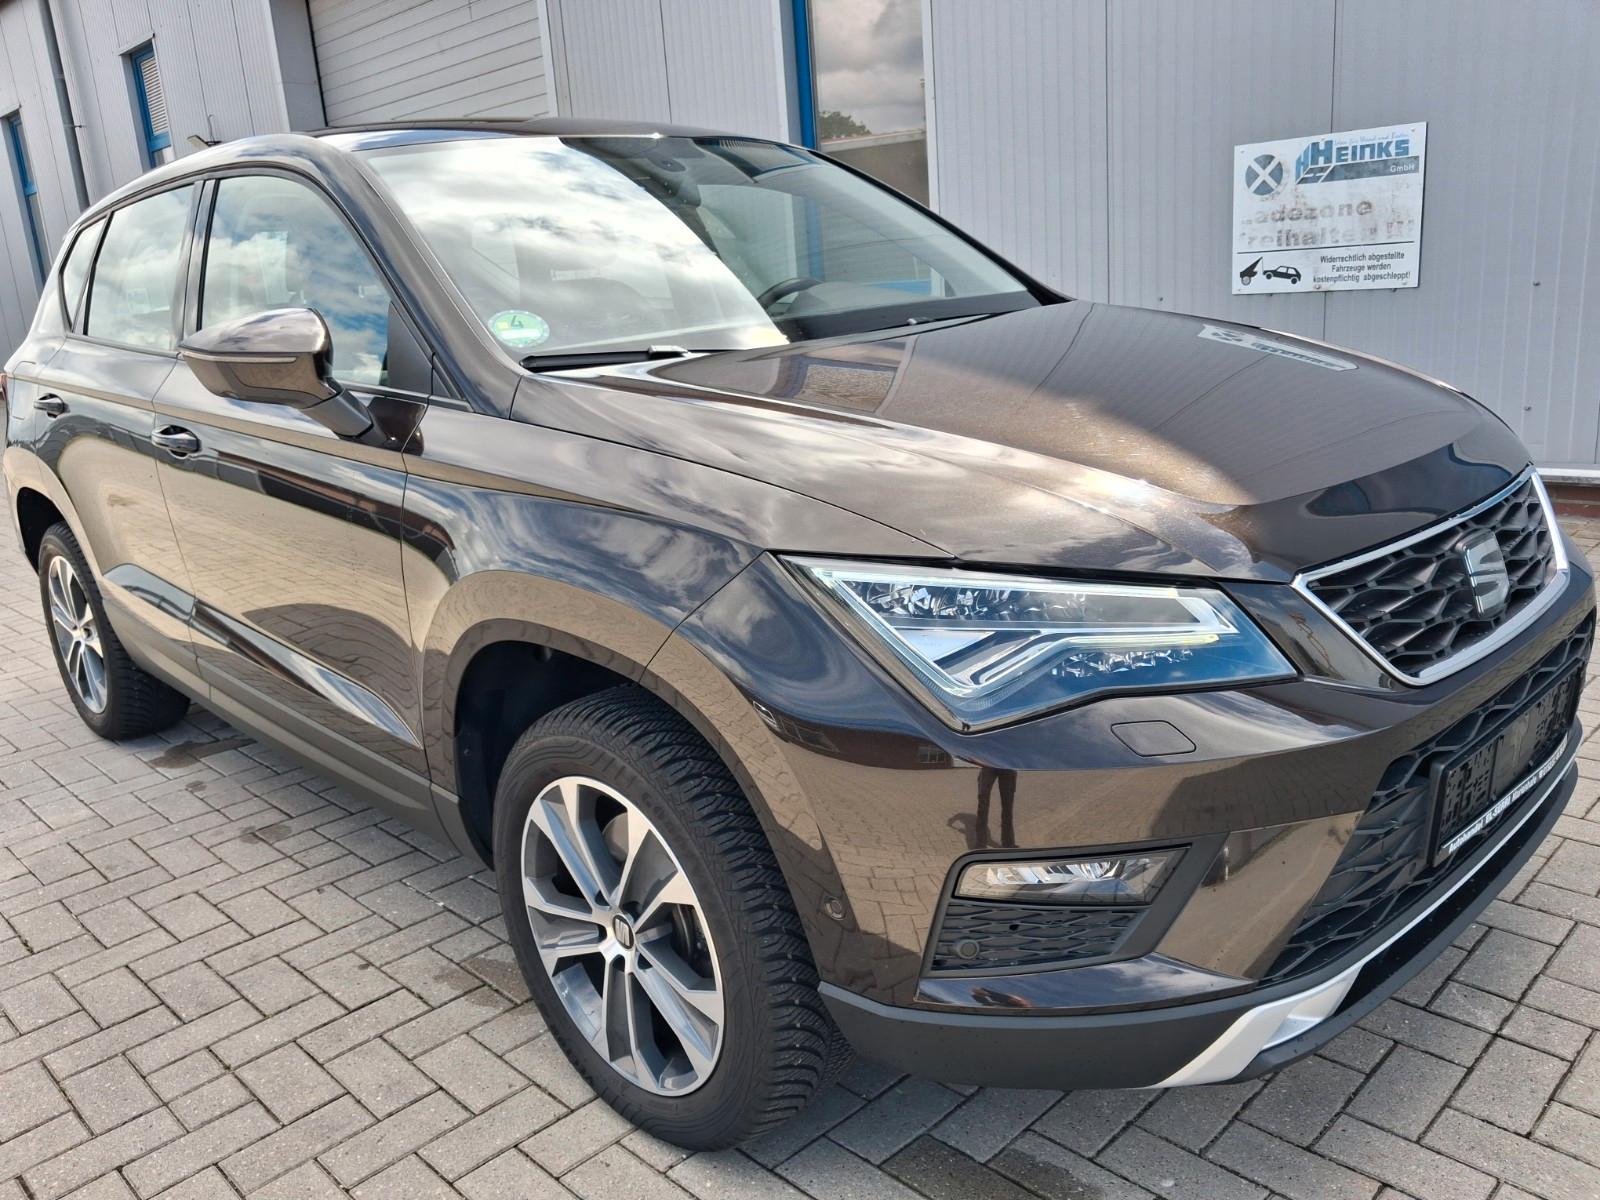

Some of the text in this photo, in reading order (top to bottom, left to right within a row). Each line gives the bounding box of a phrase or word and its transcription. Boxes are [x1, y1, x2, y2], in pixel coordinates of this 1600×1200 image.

[1389, 164, 1415, 173] GmbH
[1241, 200, 1373, 224] adezone
[1320, 251, 1405, 263] Widerrechtlich abgestellte
[1331, 262, 1392, 273] Fahrzeuge werden
[1313, 272, 1411, 283] kostenpflichtig abgeschleppt!
[510, 315, 524, 329] 4
